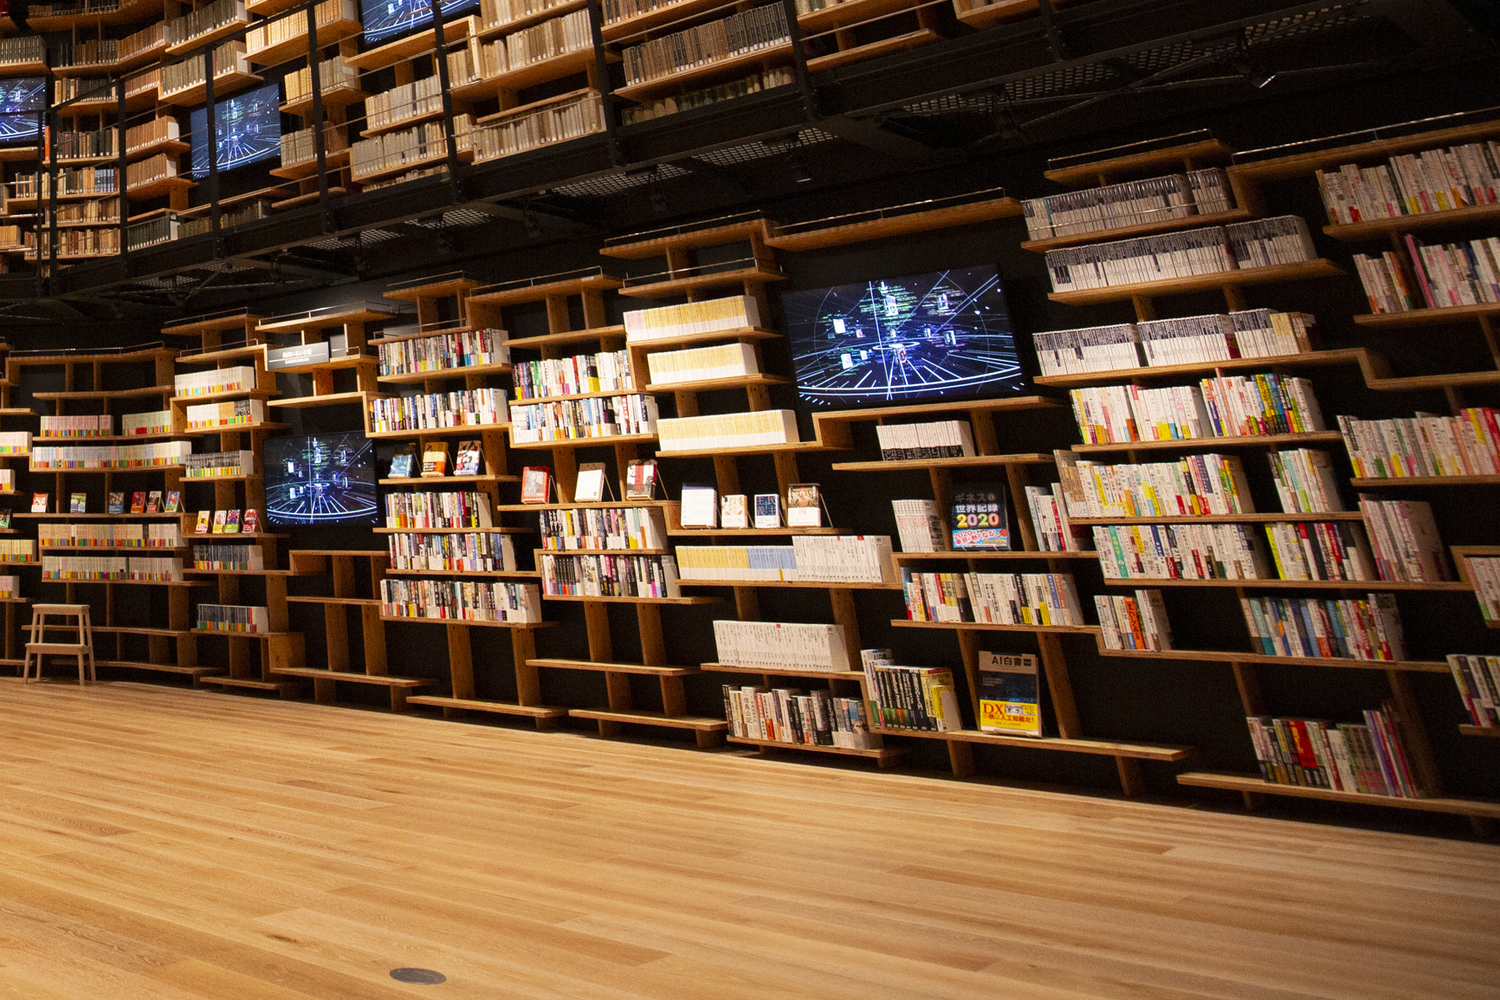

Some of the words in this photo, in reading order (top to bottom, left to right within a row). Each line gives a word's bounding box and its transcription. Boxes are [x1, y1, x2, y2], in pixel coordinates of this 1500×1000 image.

[955, 504, 999, 513] 世界記録
[956, 513, 1000, 529] 2020
[991, 656, 1023, 667] AI白書
[983, 703, 1004, 715] DX
